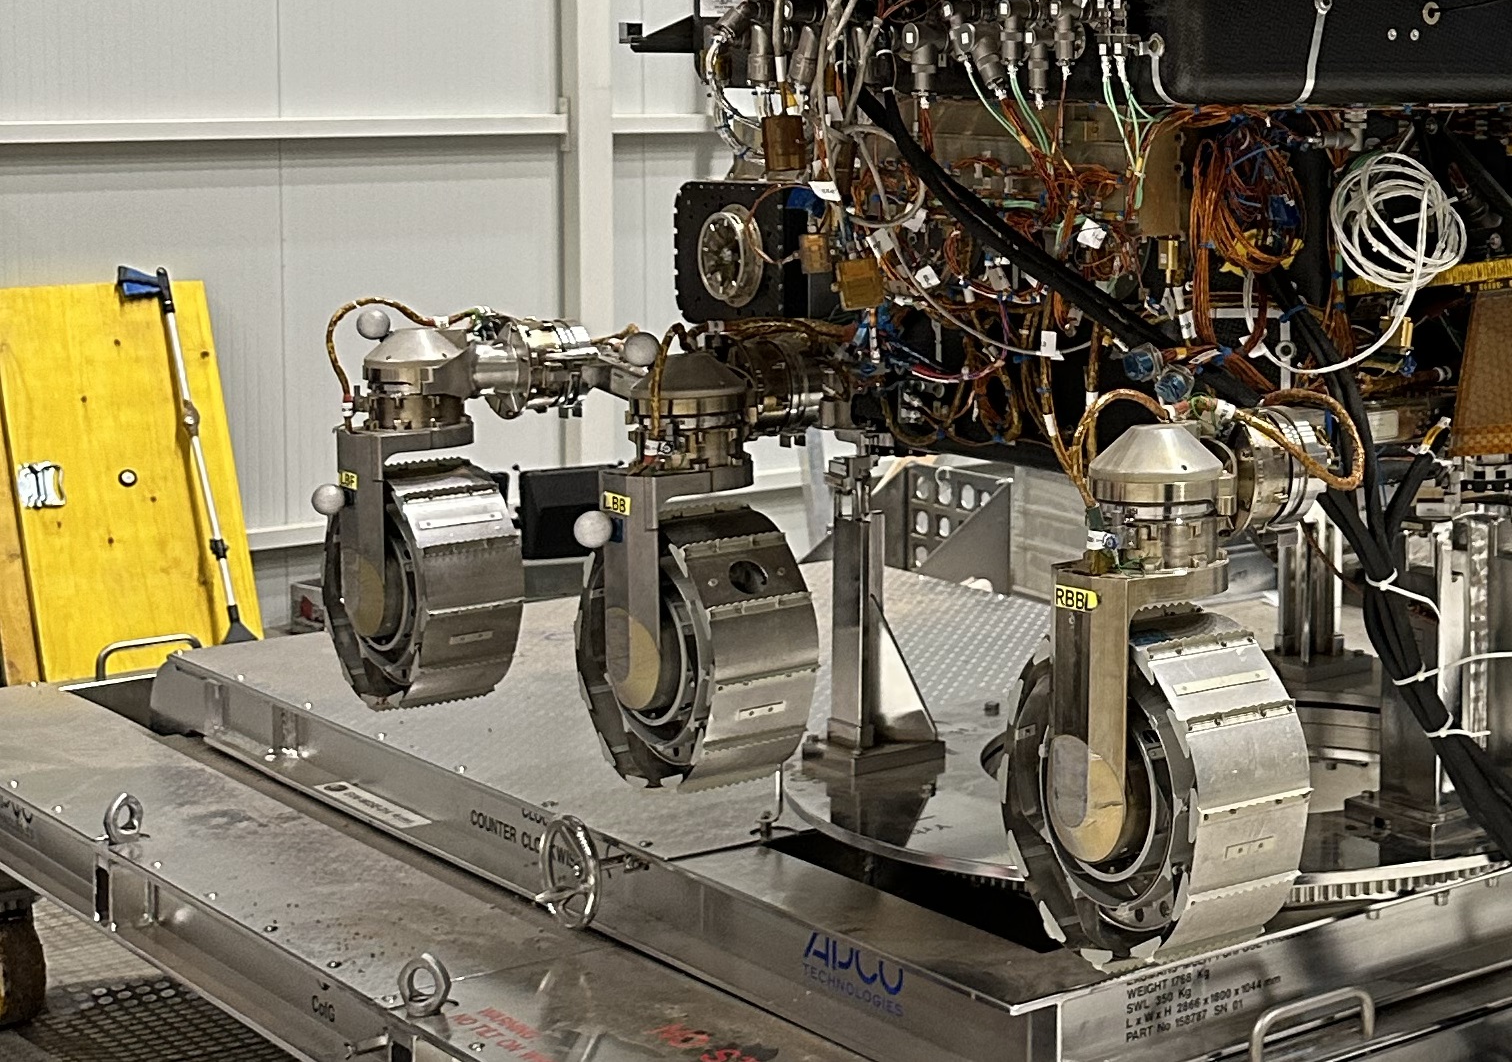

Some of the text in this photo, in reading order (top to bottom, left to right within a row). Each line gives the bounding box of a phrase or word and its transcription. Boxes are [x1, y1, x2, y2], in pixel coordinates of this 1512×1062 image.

[603, 495, 626, 513] LBB
[1055, 587, 1093, 612] RBBL
[470, 809, 516, 843] COUNTER
[803, 963, 904, 1017] TECHNOLOGIES
[1127, 979, 1168, 999] WEIGHT
[1127, 999, 1150, 1014] SWL
[1178, 987, 1191, 999] Kg
[1126, 1018, 1133, 1029] L
[1164, 1005, 1172, 1017] H
[1126, 1025, 1153, 1043] PART
[1214, 1003, 1227, 1016] SN
